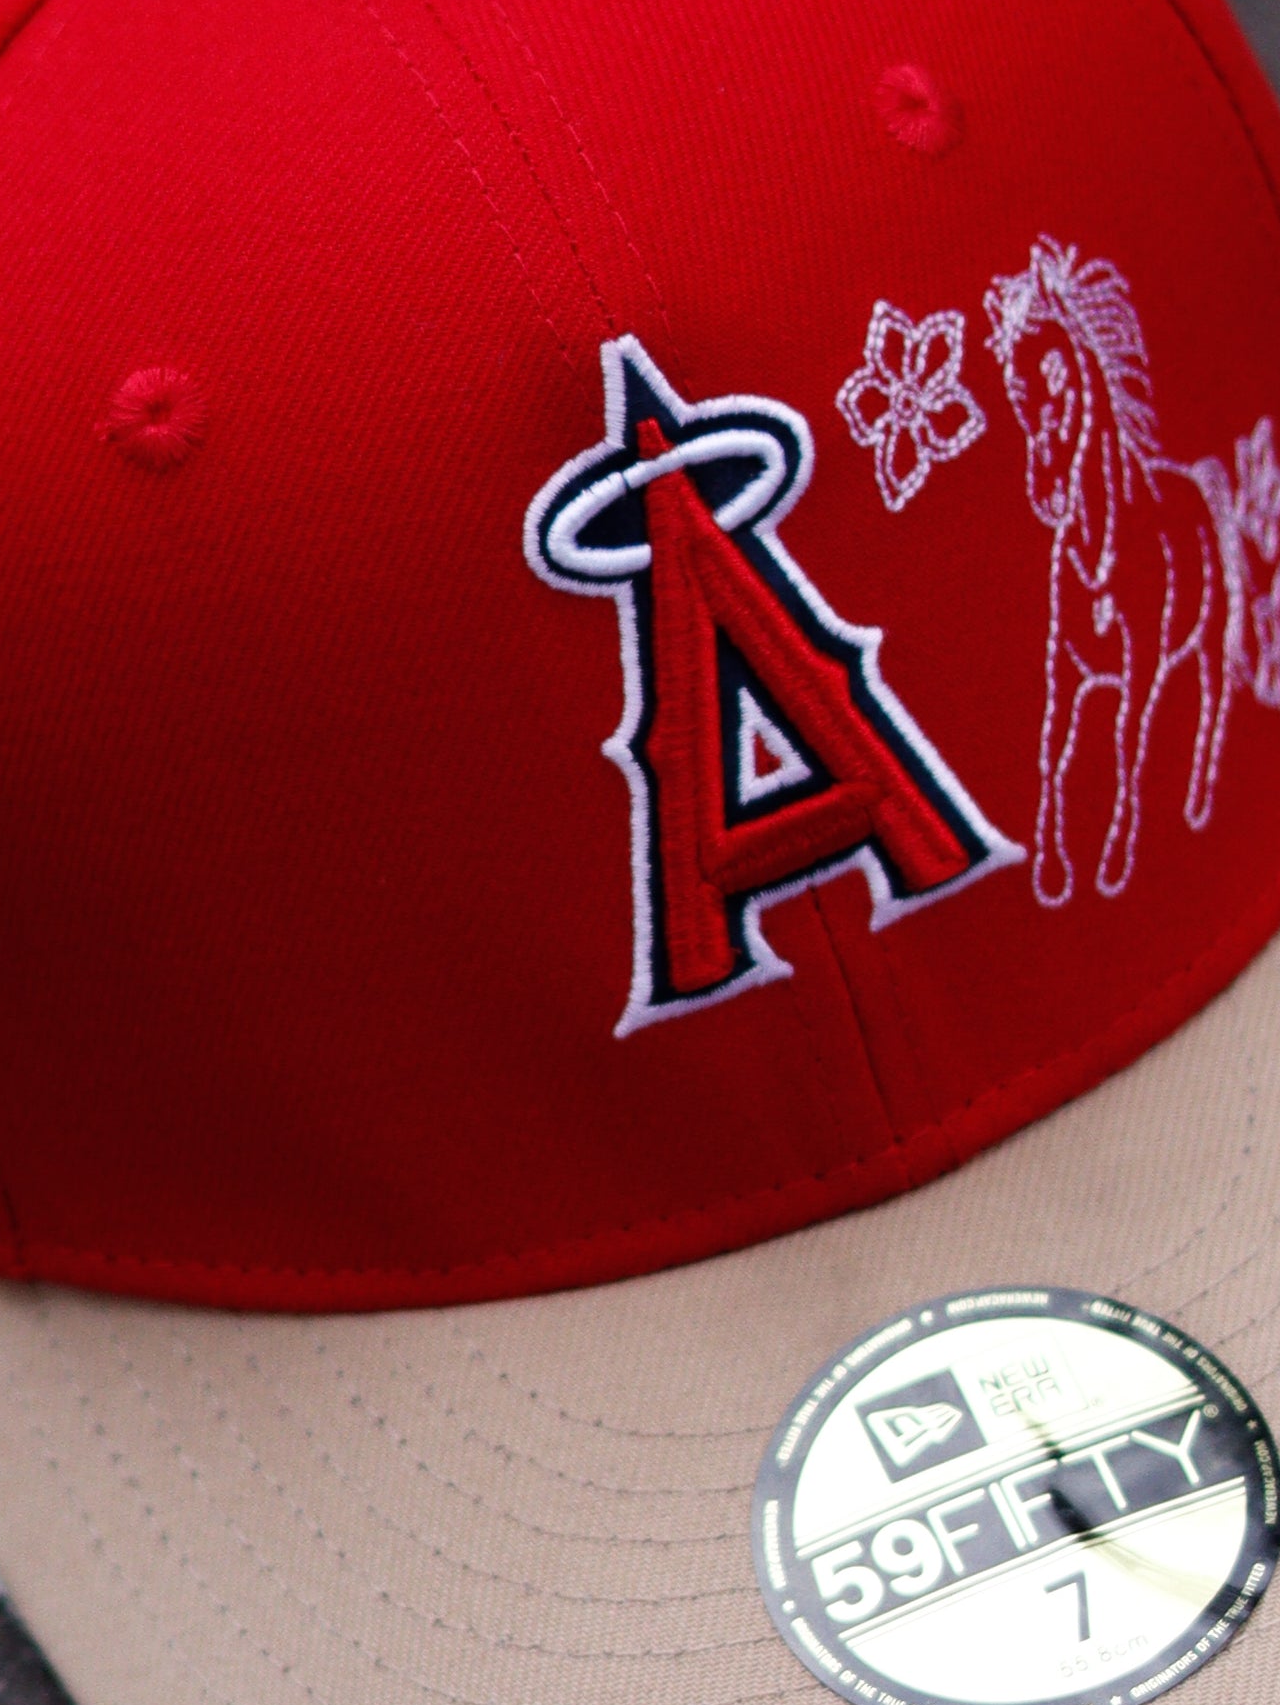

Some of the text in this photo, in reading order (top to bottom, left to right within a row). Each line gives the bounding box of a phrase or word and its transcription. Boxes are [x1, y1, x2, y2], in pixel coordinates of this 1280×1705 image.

[526, 334, 1027, 1039] A
[978, 1353, 1050, 1393] NEW
[990, 1377, 1062, 1417] ERA
[1044, 1568, 1091, 1642] 7
[1130, 1562, 1266, 1698] ORIGINATORS OF THE TRUE FITTED
[1058, 1633, 1149, 1678] 558cm
[854, 1679, 877, 1699] THE
